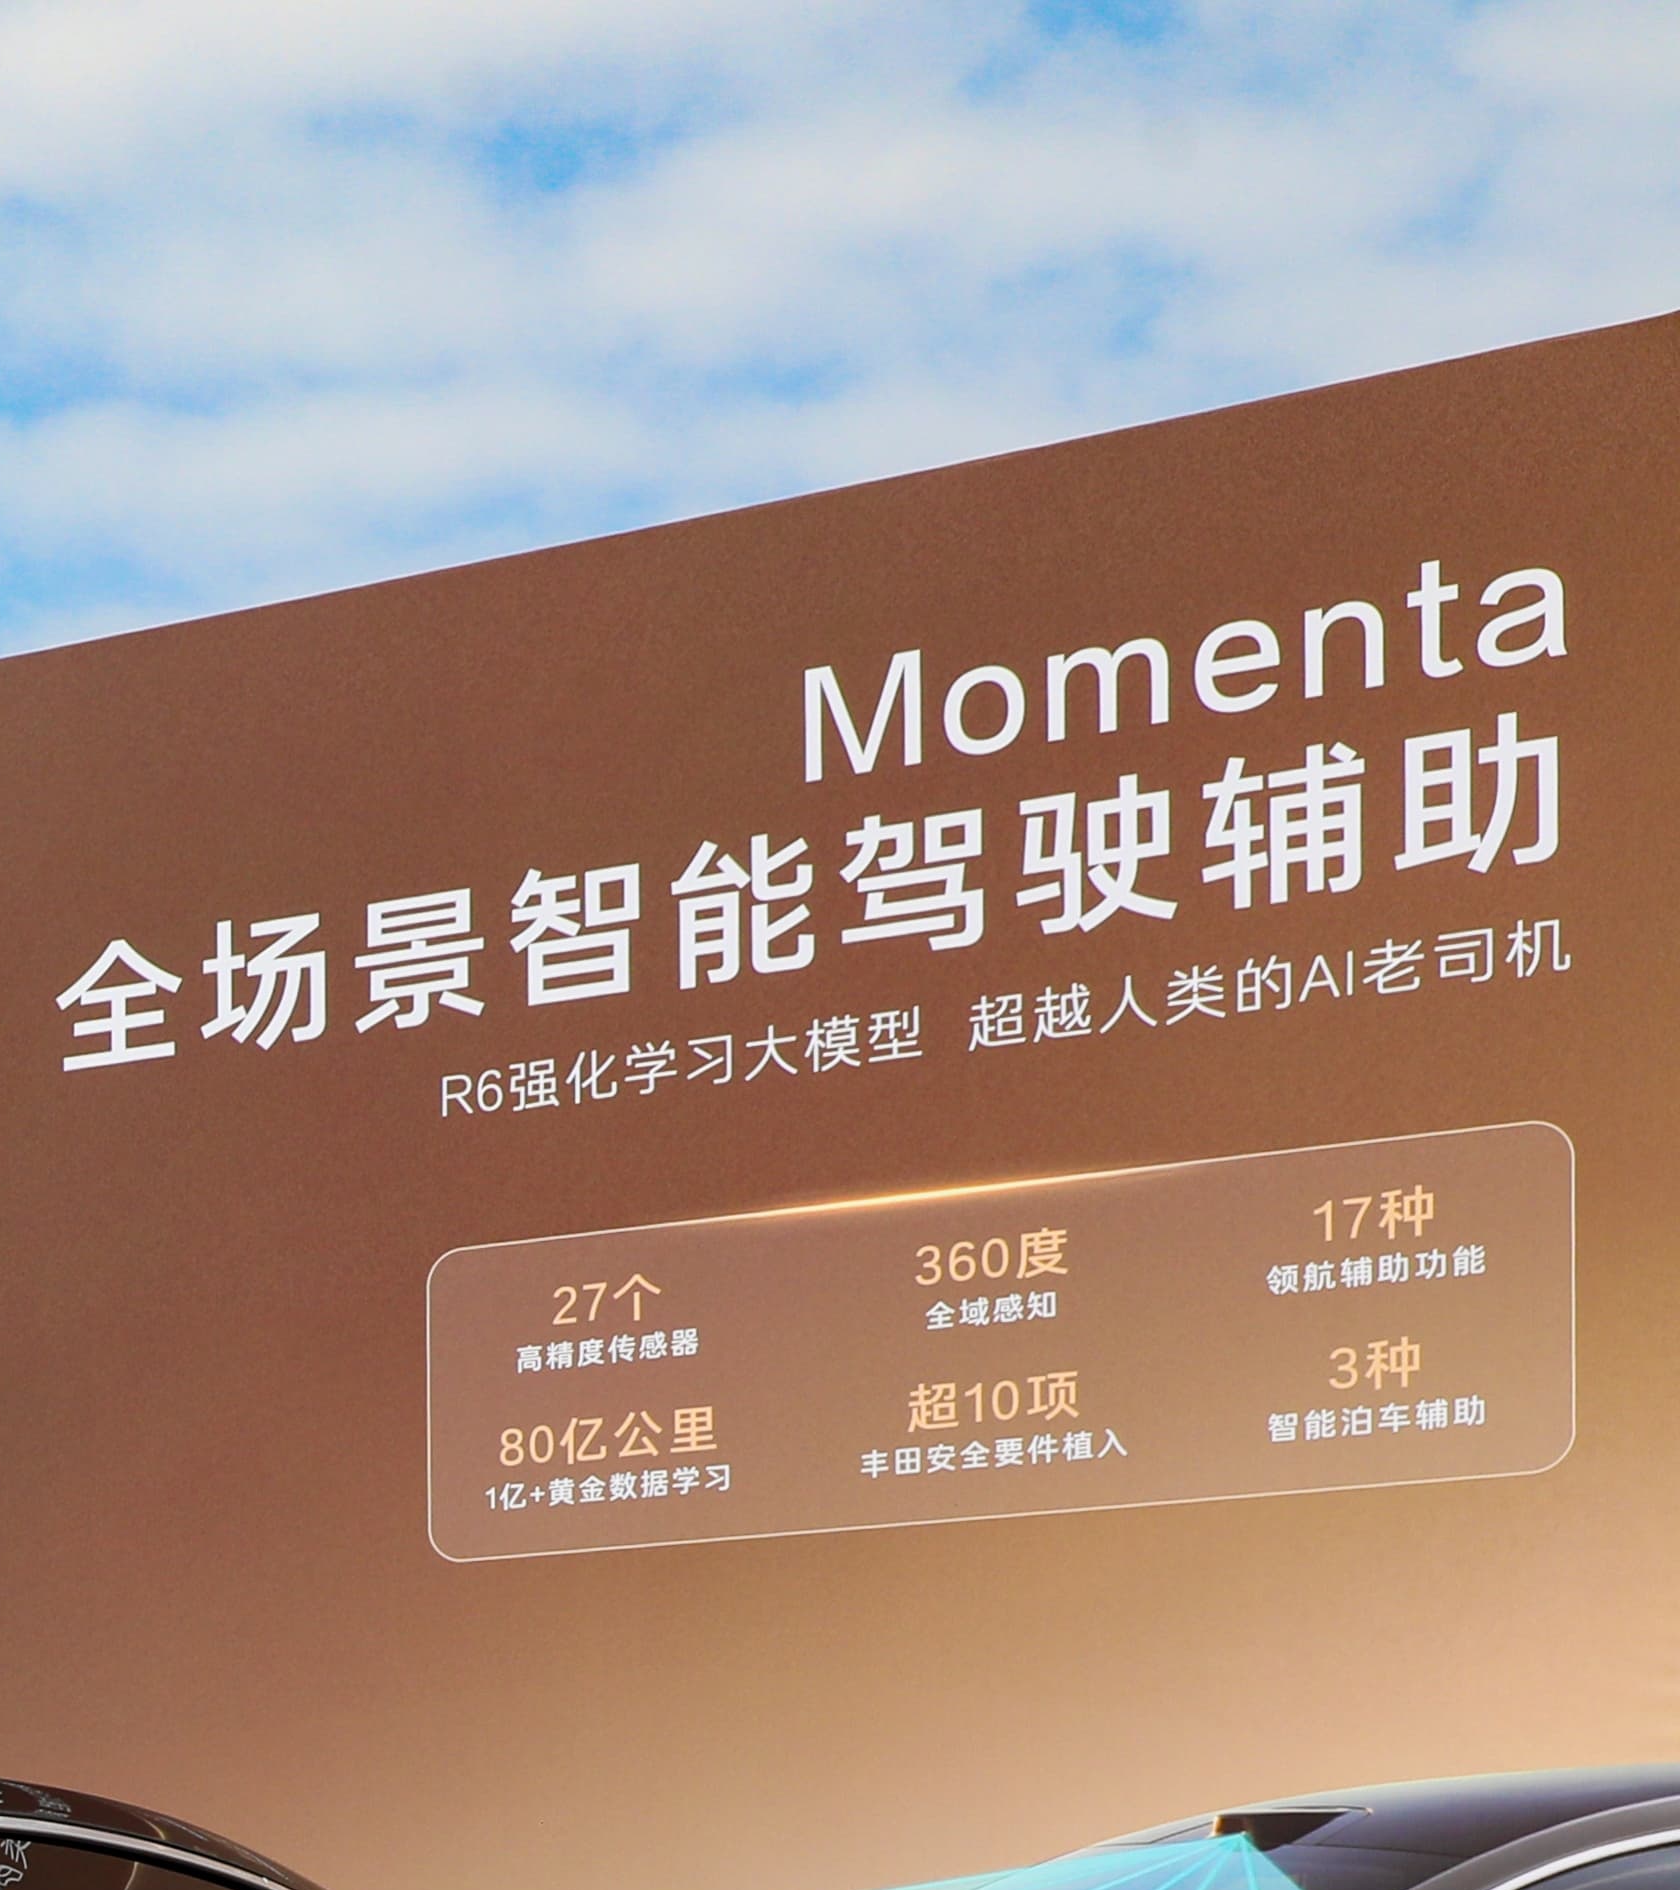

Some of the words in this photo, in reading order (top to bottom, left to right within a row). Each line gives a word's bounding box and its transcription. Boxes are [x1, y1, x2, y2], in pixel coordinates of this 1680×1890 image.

[804, 559, 1568, 783] Momenta
[55, 710, 1562, 1074] 全场景智能驾驶辅助
[441, 1005, 923, 1118] R6强化学习大模型
[968, 918, 1571, 1052] 超越人类的AI老司机
[1313, 1184, 1434, 1242] 17种
[915, 1227, 1068, 1286] 360度
[1265, 1244, 1486, 1295] 领航辅助功能
[552, 1273, 662, 1325] 27个
[925, 1291, 1057, 1330] 全域感知
[516, 1327, 699, 1374] 高精度传感器
[1328, 1335, 1421, 1391] 3种
[907, 1370, 1079, 1433] 超10项
[1267, 1394, 1485, 1442] 智能泊车辅助
[499, 1406, 718, 1467] 80亿公里
[860, 1428, 1128, 1479] 丰田安全要件植入
[485, 1464, 730, 1511] 1亿+黄金数据学习
